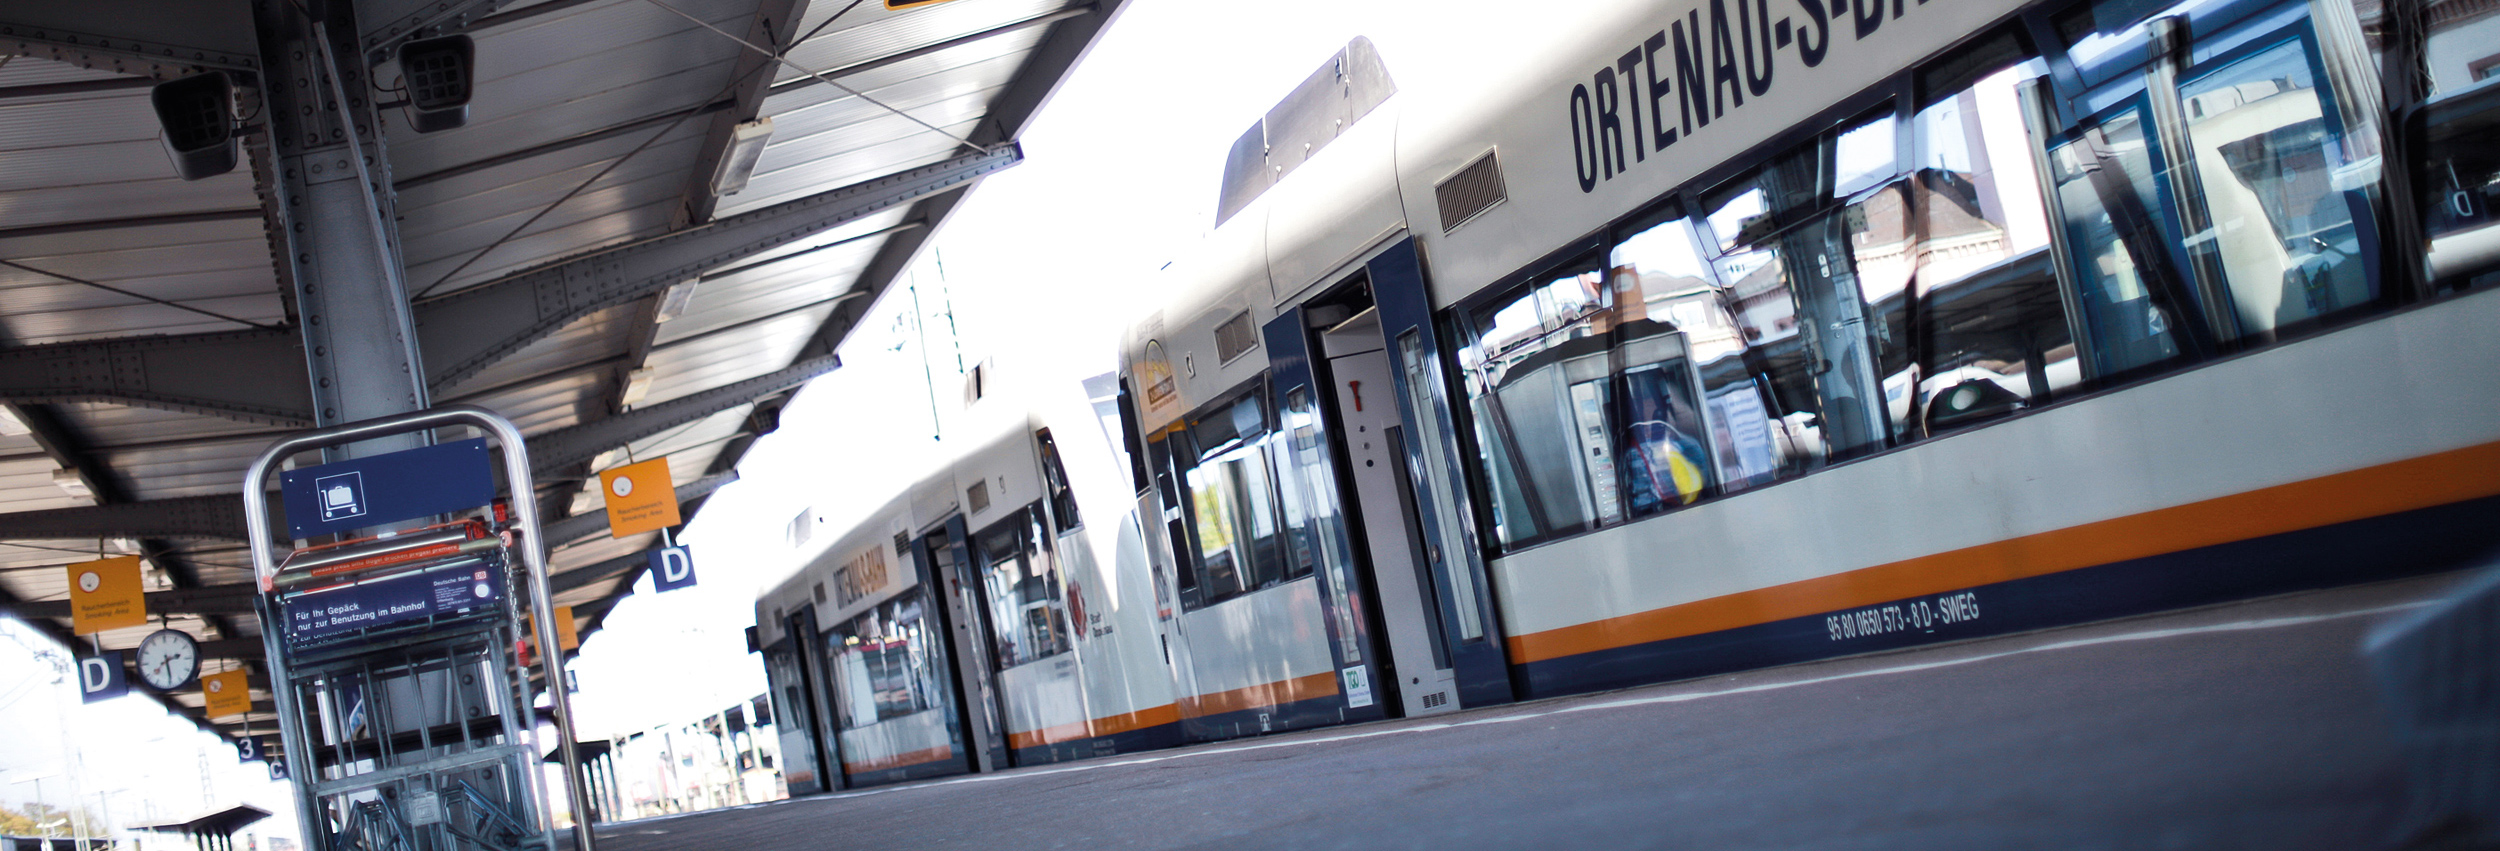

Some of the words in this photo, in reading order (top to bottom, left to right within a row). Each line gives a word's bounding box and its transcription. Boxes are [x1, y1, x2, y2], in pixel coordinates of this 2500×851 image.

[661, 547, 690, 583] D
[433, 578, 456, 586] Deutsche
[296, 612, 309, 620] Für
[312, 609, 324, 617] Ihr
[327, 602, 359, 616] Gepäck
[297, 622, 311, 631] nur
[315, 620, 328, 629] zur
[331, 611, 376, 625] Benutzung
[378, 609, 388, 617] im
[391, 601, 425, 615] Bahnhof
[1827, 616, 1841, 641] 95
[1842, 614, 1856, 639] 80
[1856, 609, 1883, 636] 0650
[1883, 605, 1904, 632] 573
[1910, 602, 1921, 629] 8
[1920, 601, 1932, 628] D
[1939, 592, 1980, 624] SWEG
[81, 658, 110, 693] D
[239, 738, 254, 759] 3
[269, 761, 283, 779] C
